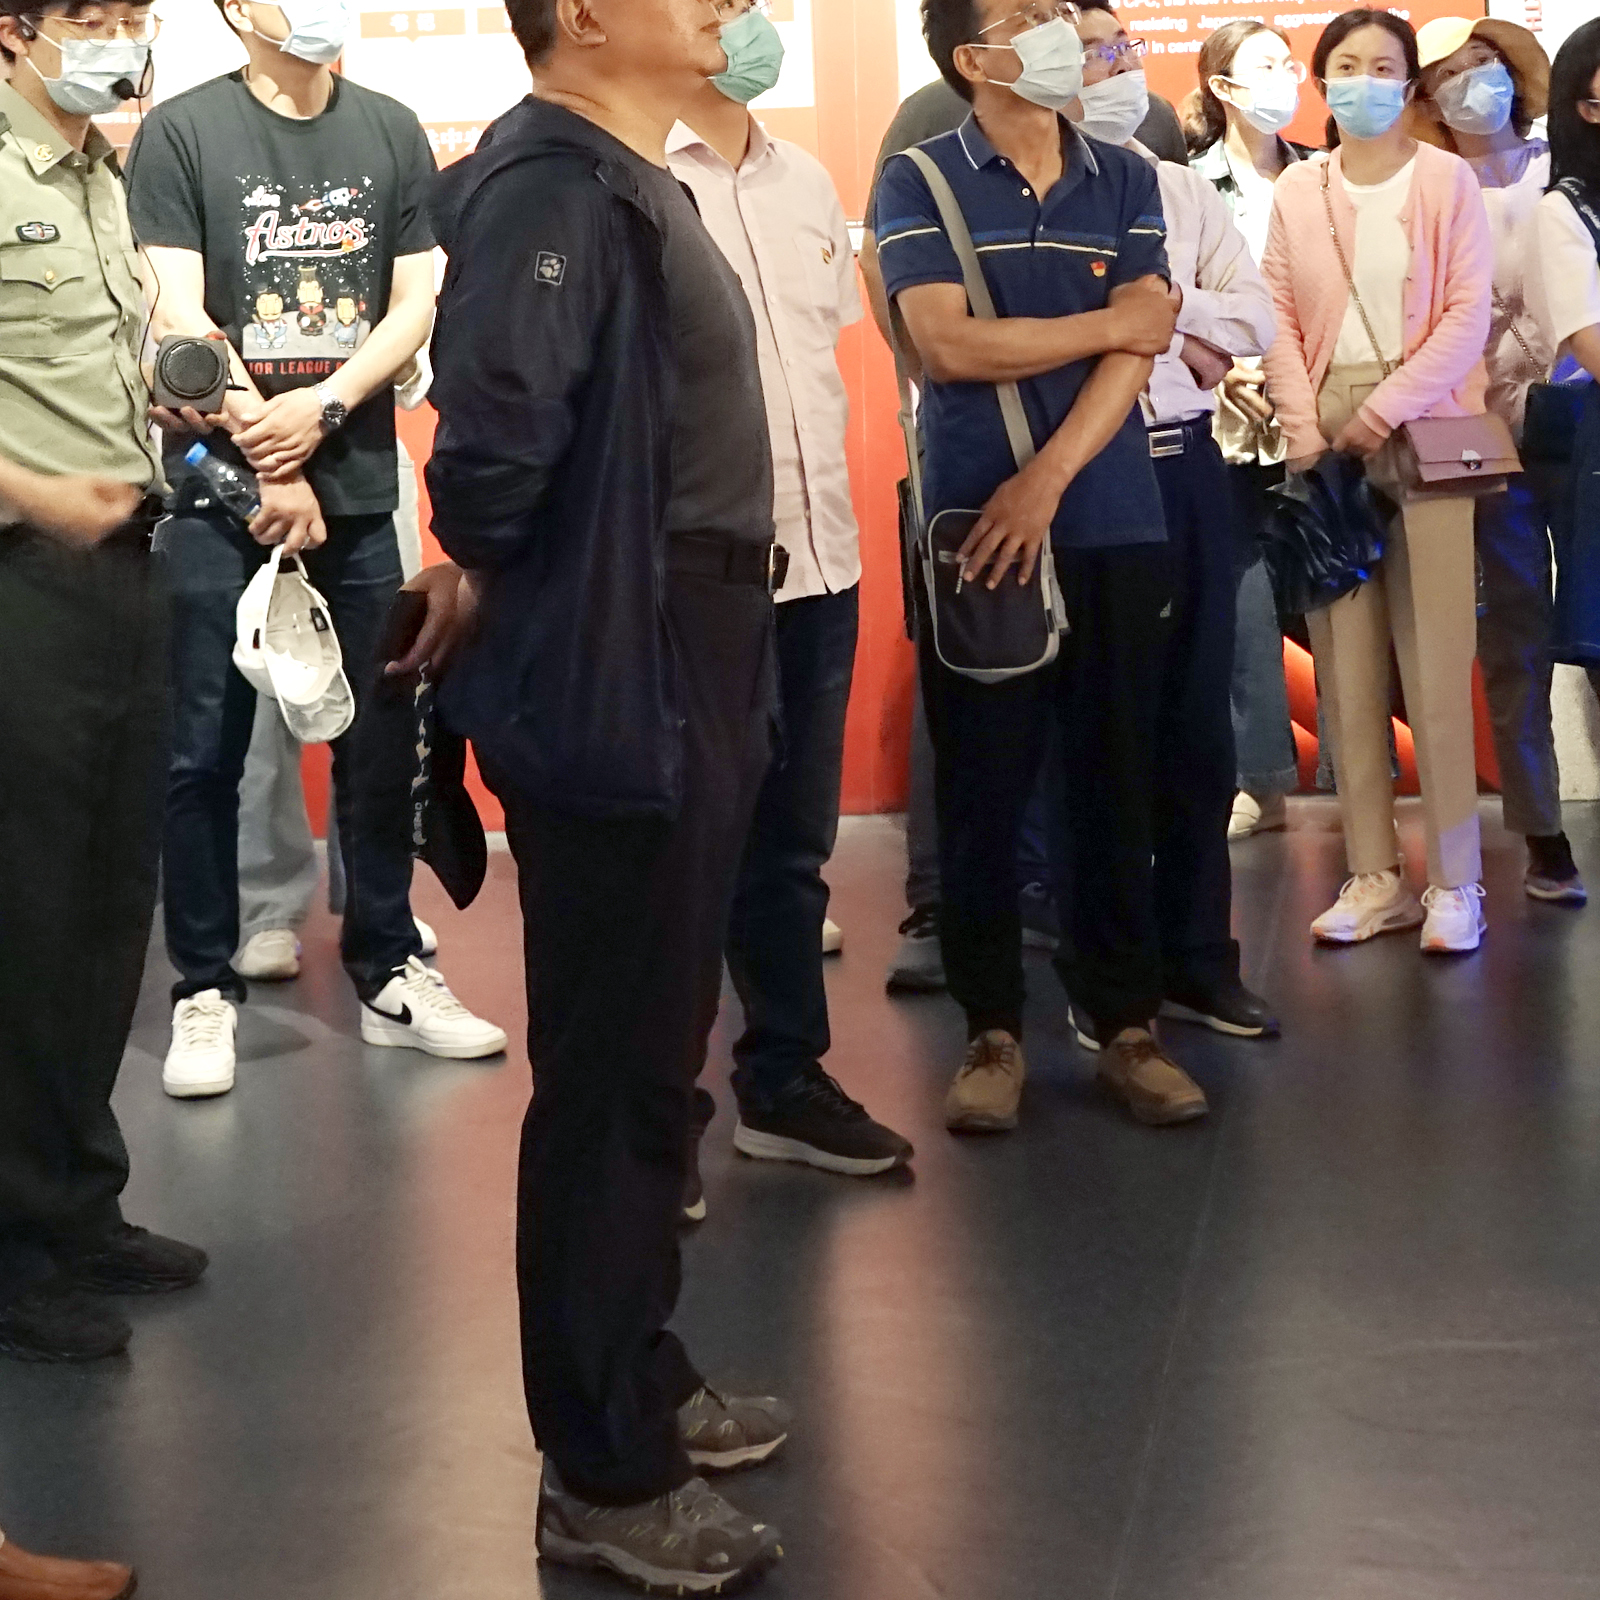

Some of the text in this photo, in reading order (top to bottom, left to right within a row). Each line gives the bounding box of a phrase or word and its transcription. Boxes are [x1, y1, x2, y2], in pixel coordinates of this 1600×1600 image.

[1130, 16, 1187, 33] resisting
[244, 210, 369, 267] Astros
[280, 361, 331, 375] LEAGUE
